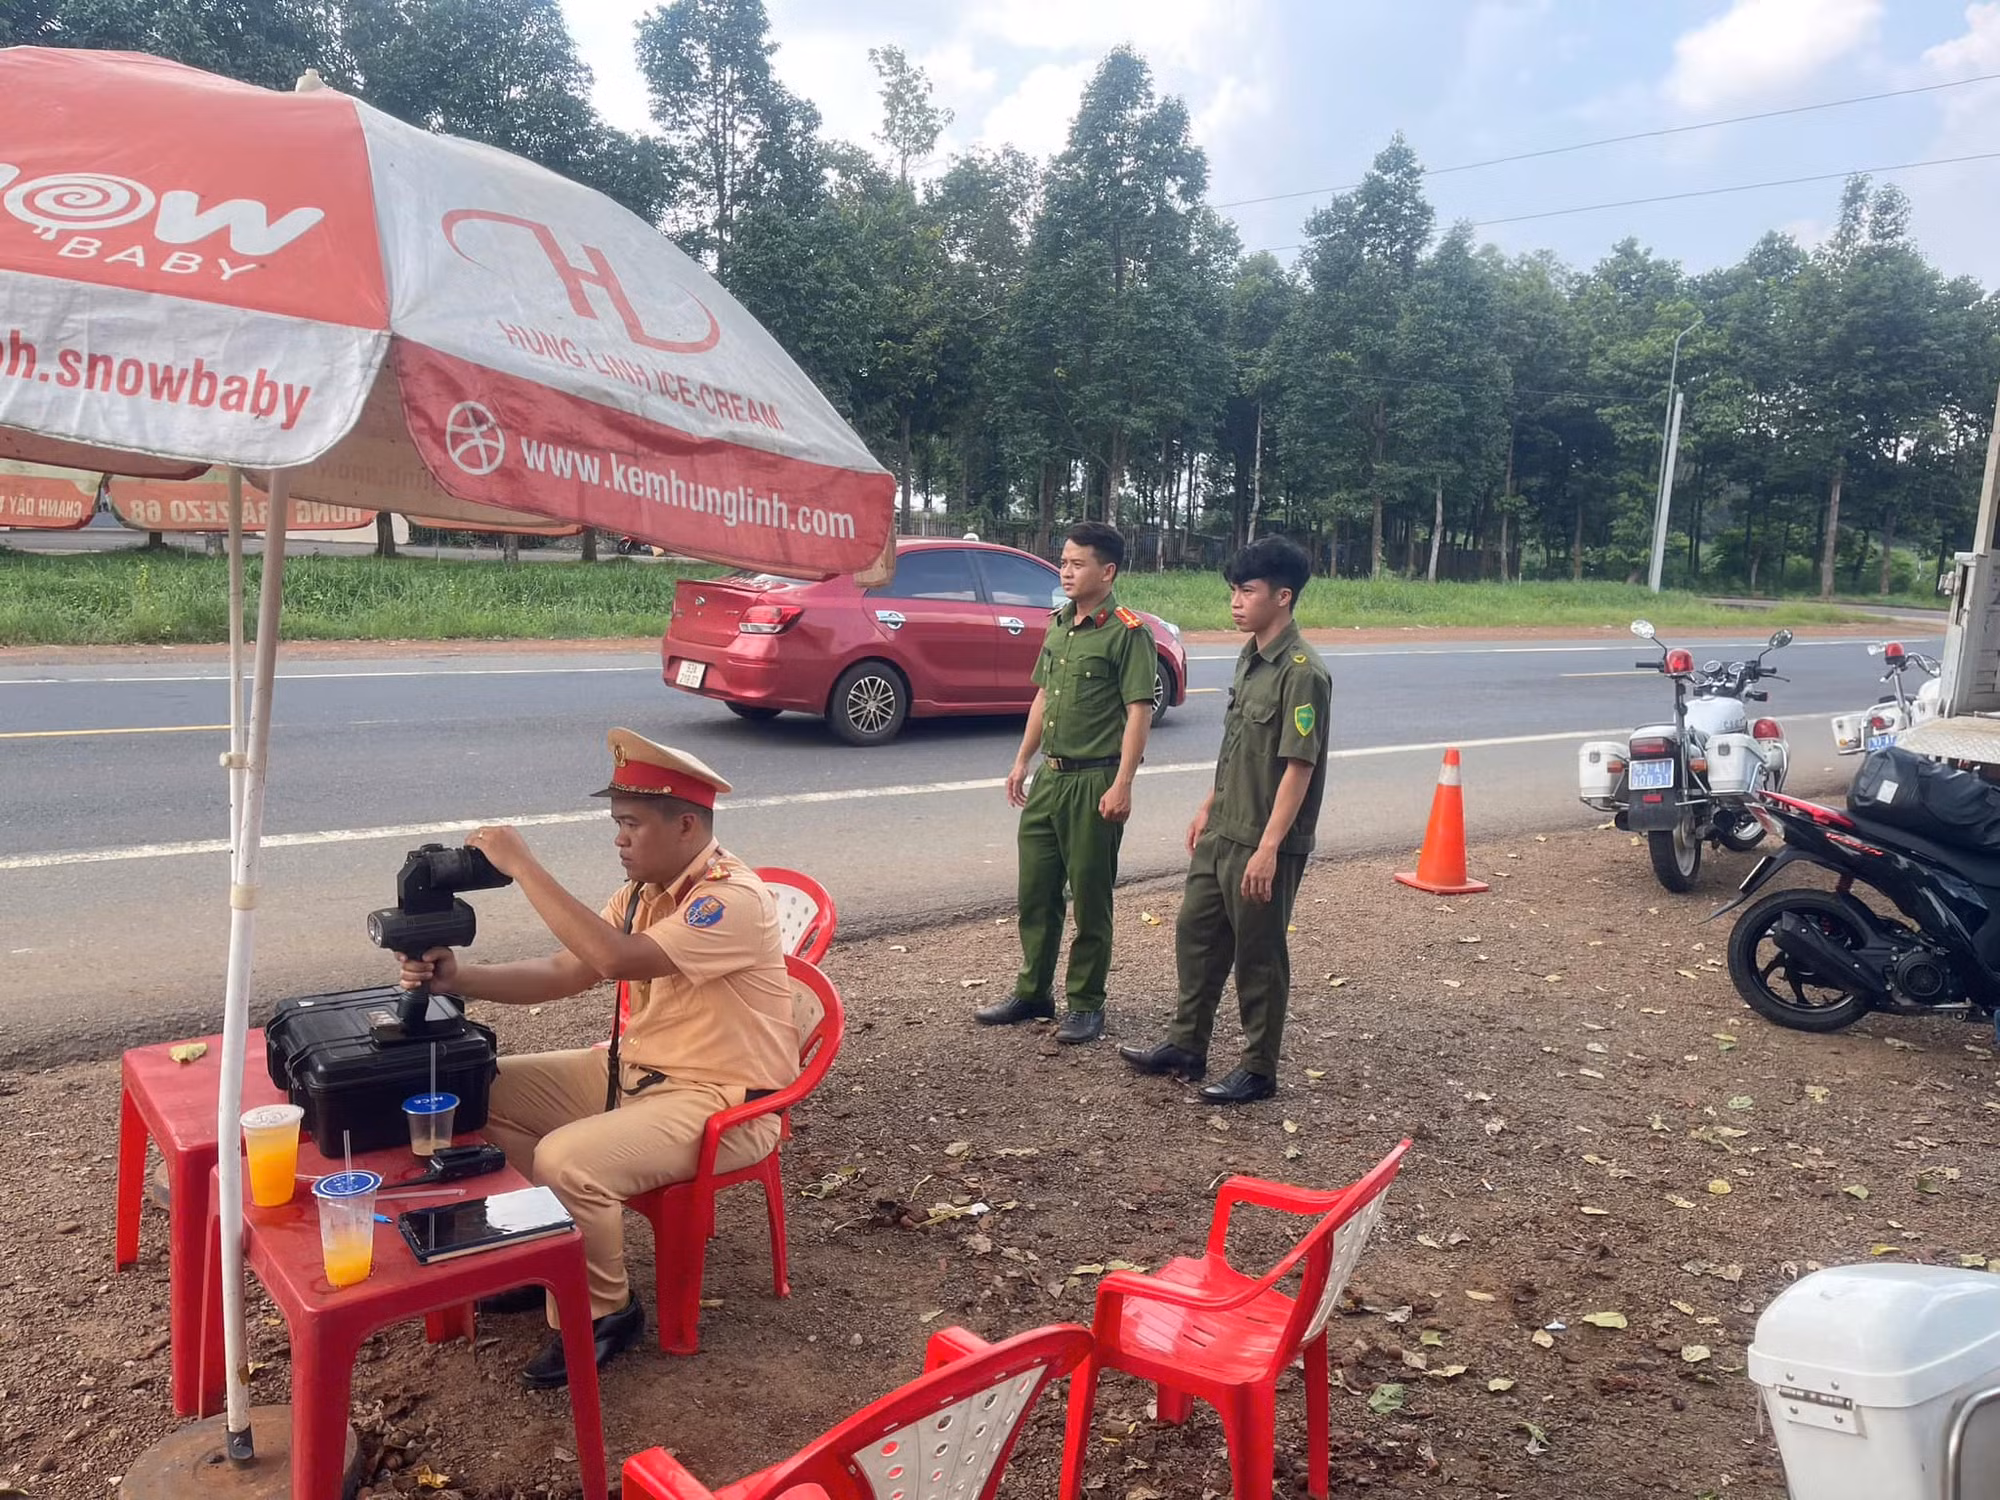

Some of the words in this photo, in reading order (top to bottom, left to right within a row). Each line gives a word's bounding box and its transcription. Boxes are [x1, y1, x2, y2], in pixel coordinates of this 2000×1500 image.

[57, 236, 257, 281] BABY
[0, 329, 311, 430] h.snowbaby
[497, 319, 586, 369] HUNG
[586, 347, 651, 391] LINH
[653, 369, 696, 408] ICE
[700, 382, 785, 430] CREAM
[520, 436, 855, 539] www.kemhunglinh.com
